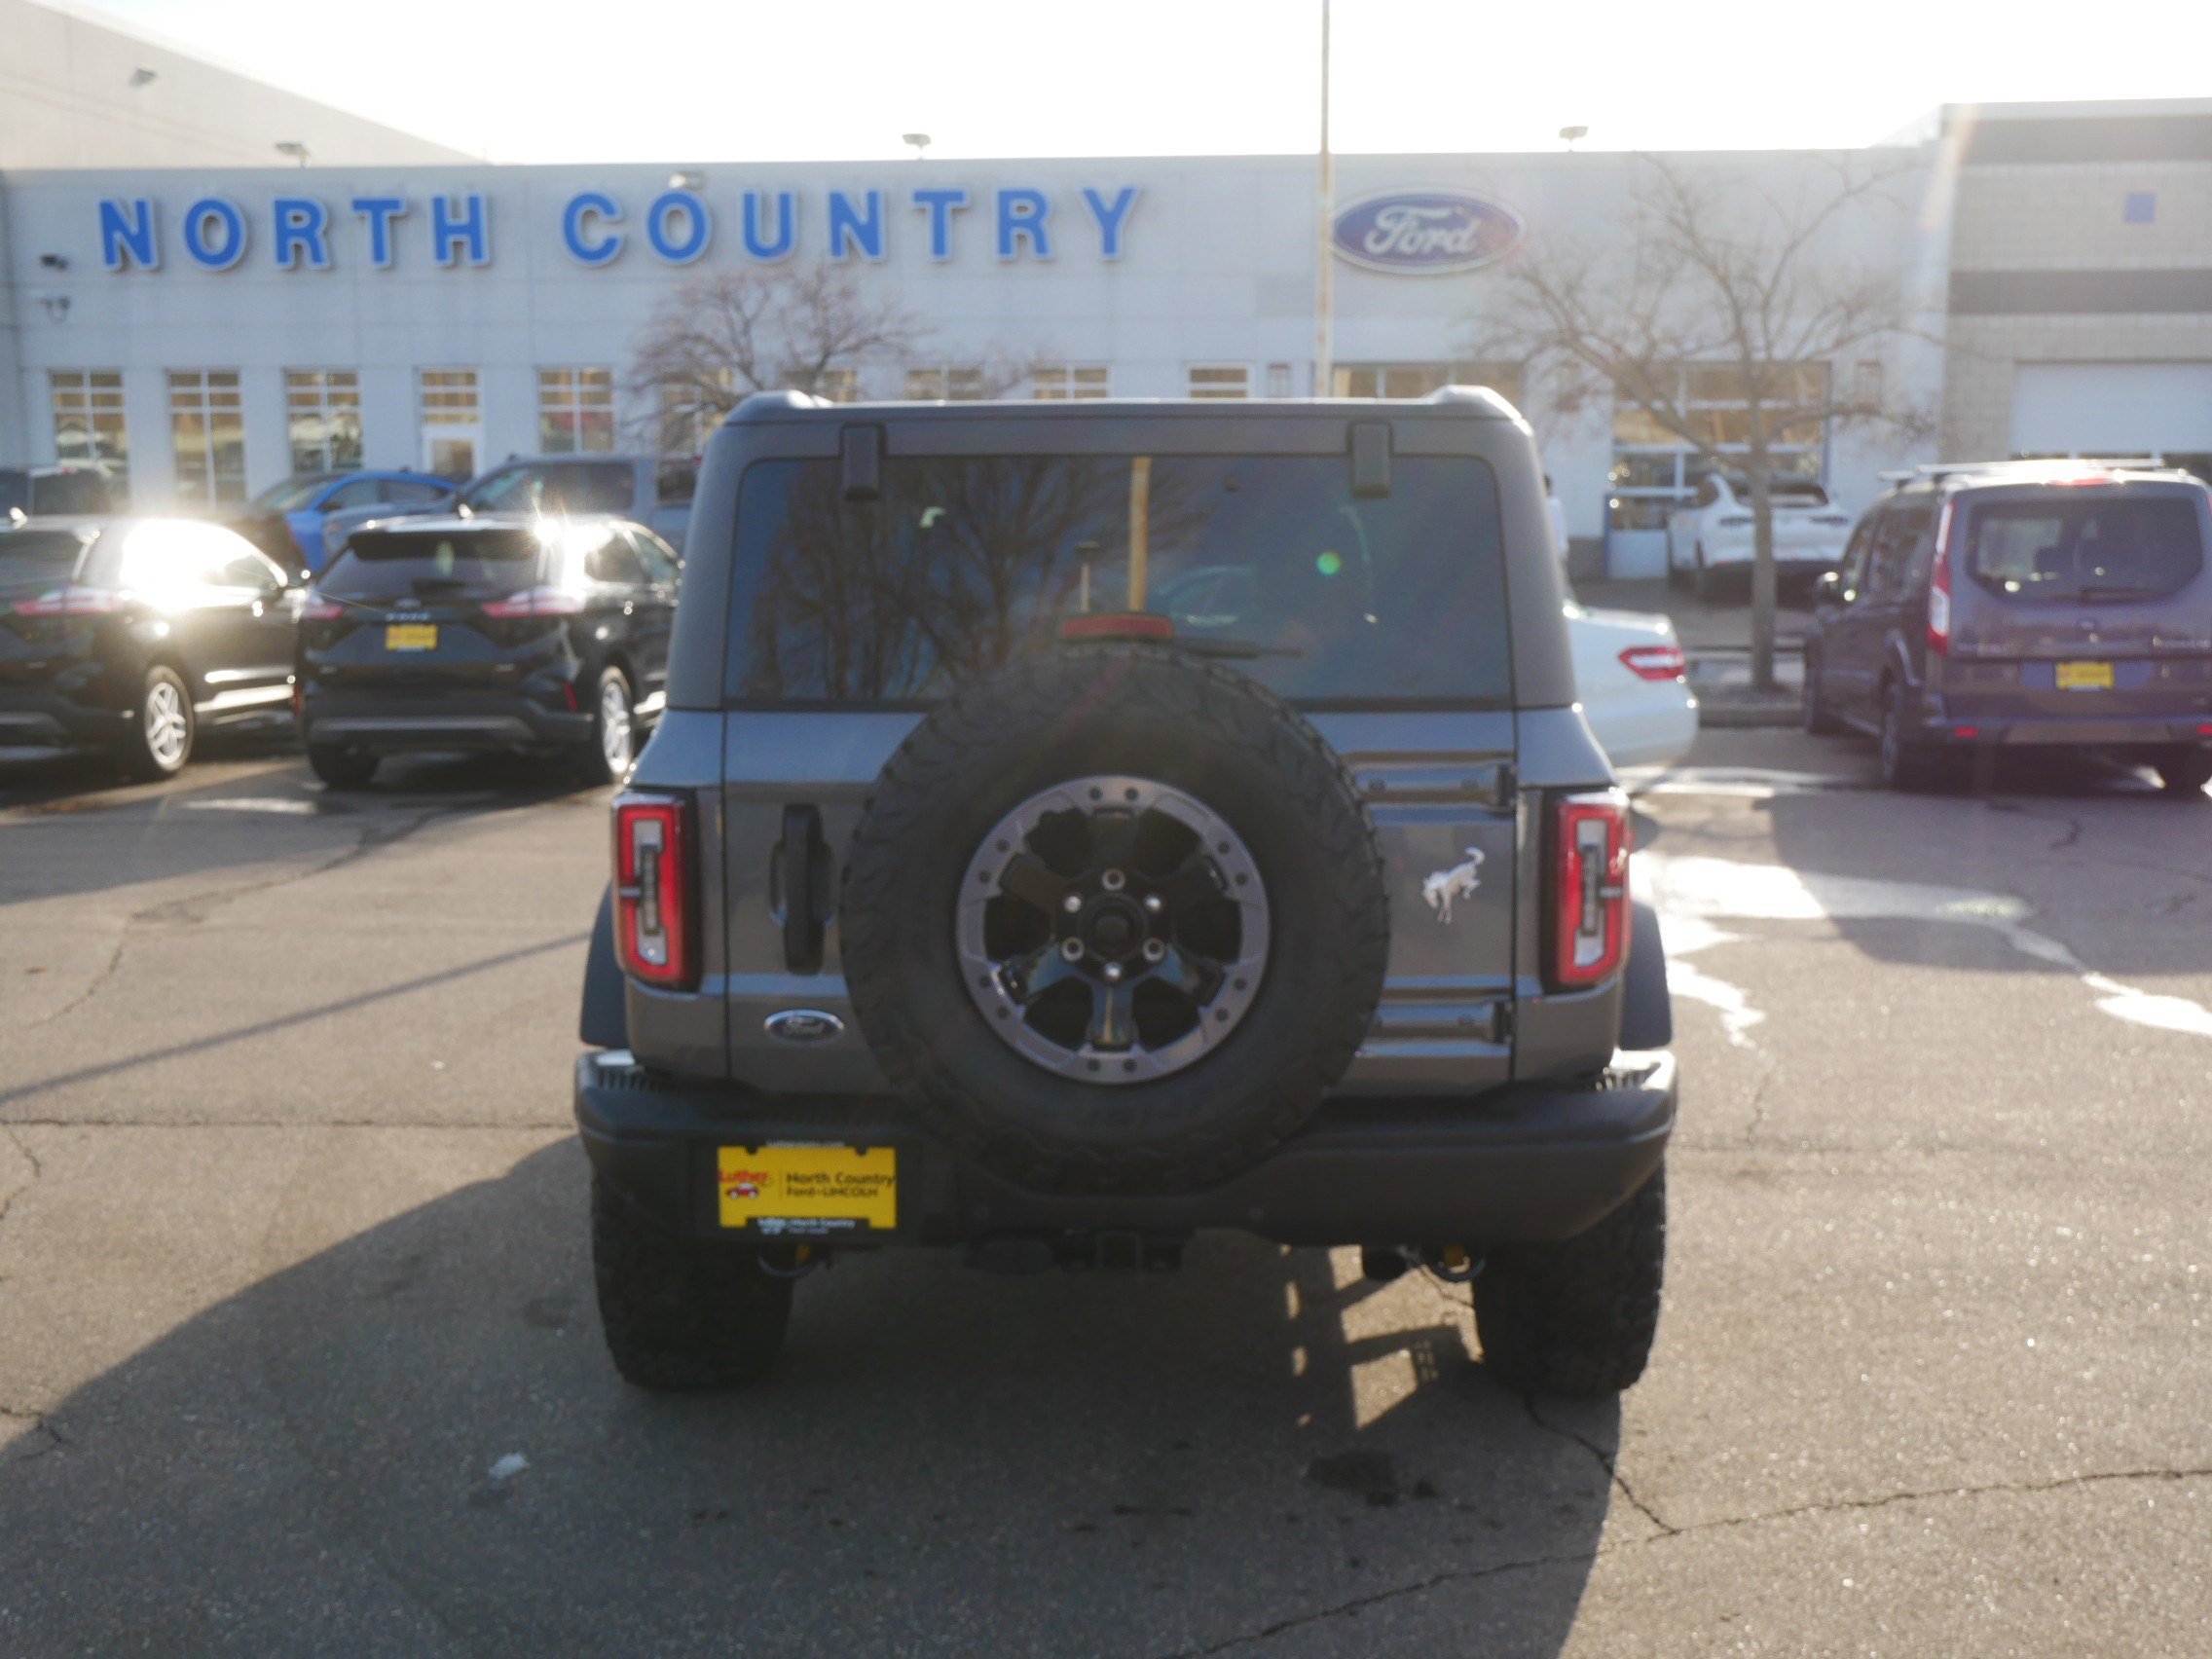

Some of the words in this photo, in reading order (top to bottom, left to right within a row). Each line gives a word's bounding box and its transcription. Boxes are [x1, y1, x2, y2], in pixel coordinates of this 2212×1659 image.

[98, 194, 488, 269] NORTH
[562, 187, 1137, 265] COUNTRY
[1362, 204, 1482, 255] Ford
[787, 1171, 830, 1184] North
[835, 1171, 895, 1187] Country
